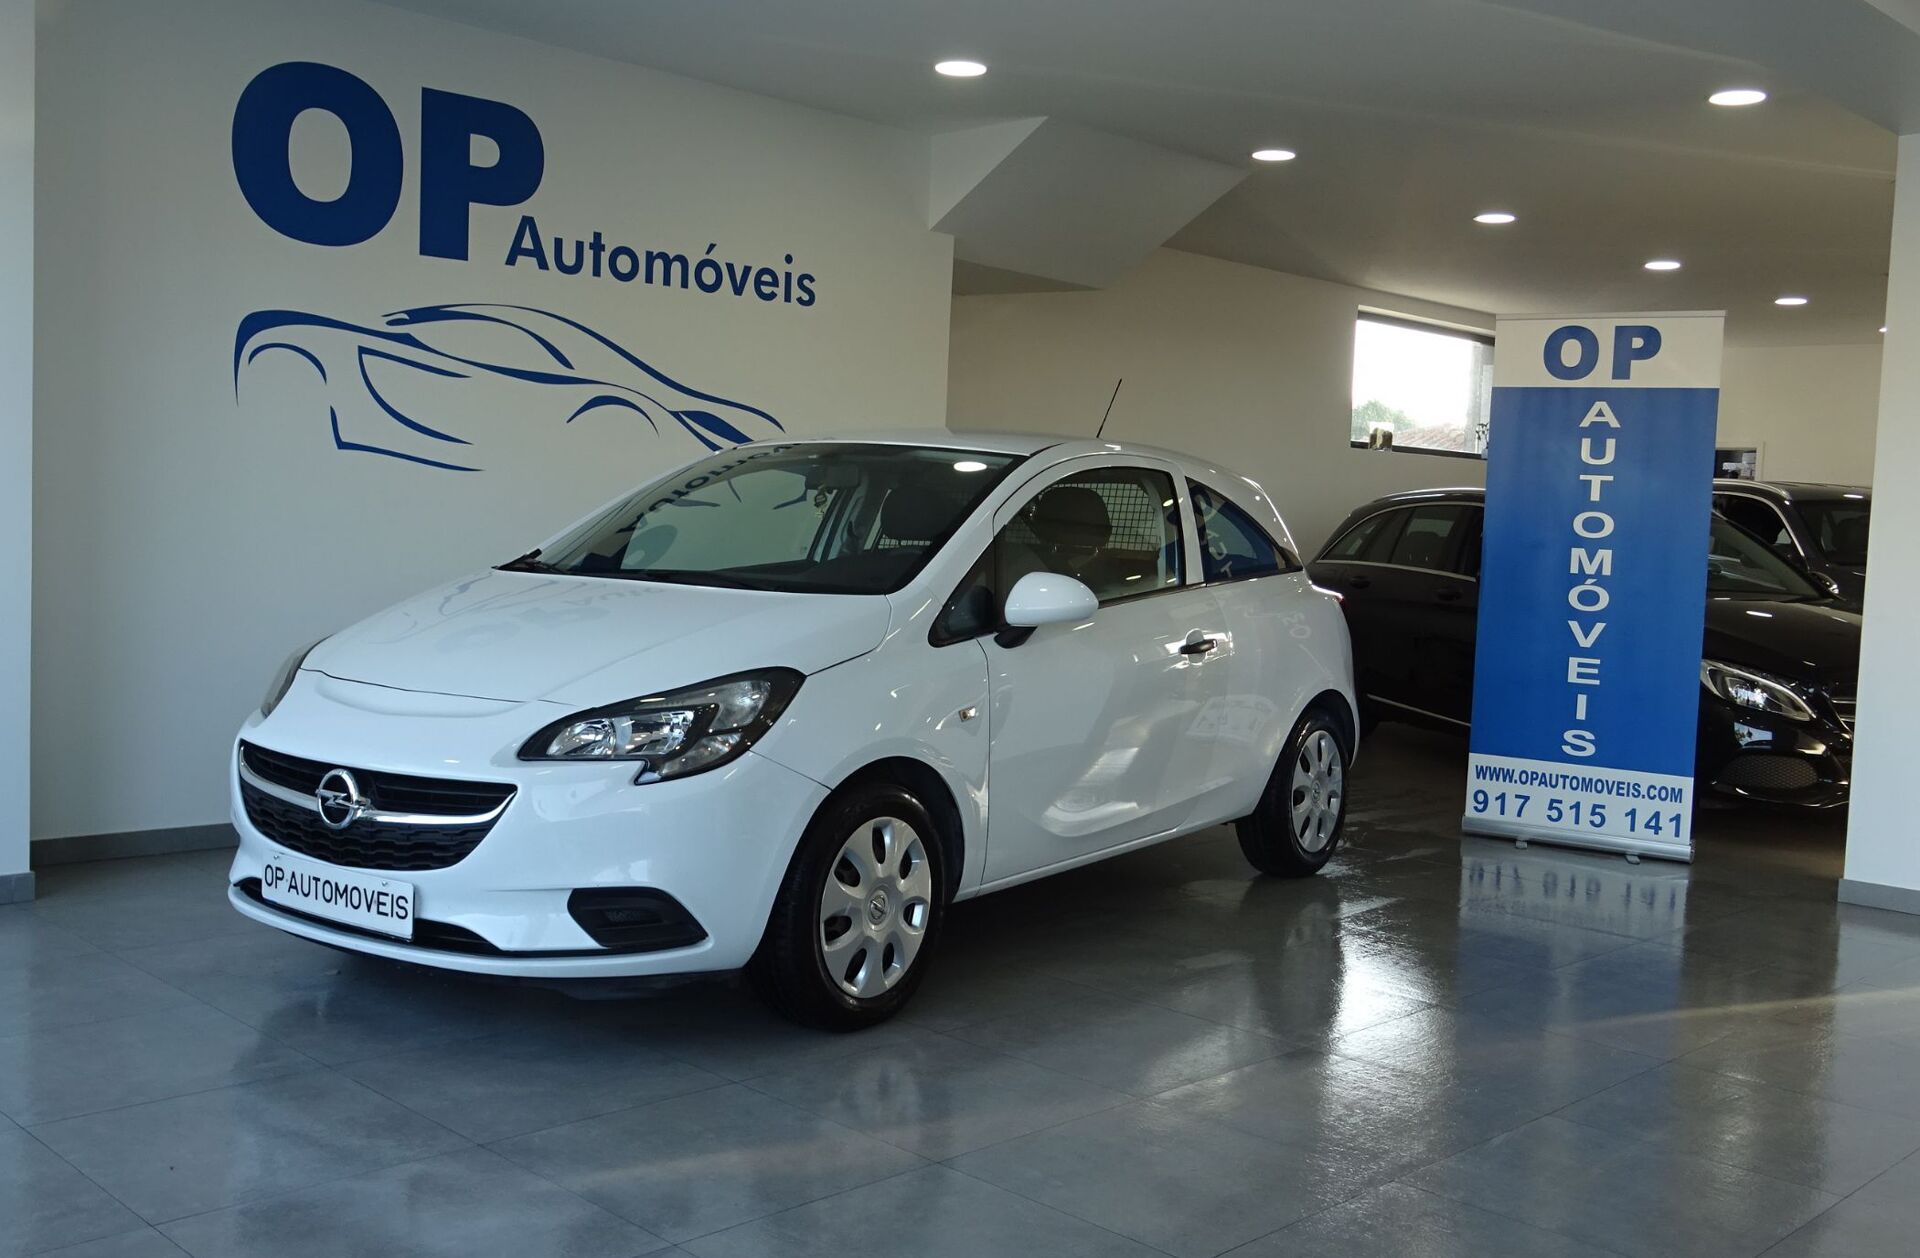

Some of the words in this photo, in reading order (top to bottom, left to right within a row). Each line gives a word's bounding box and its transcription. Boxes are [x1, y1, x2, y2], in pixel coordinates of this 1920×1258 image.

[231, 61, 545, 262] OP
[505, 215, 817, 307] Automóveis
[1543, 325, 1662, 381] OP
[1561, 400, 1621, 758] AUTOMÓVEIS
[1475, 764, 1684, 804] WWW.OPAUTOMOVEIS.COM
[1472, 788, 1531, 819] 917
[1546, 798, 1607, 829] 515
[1624, 807, 1683, 839] 141
[264, 863, 285, 890] OP
[287, 870, 409, 921] AUTOMOVEIS
